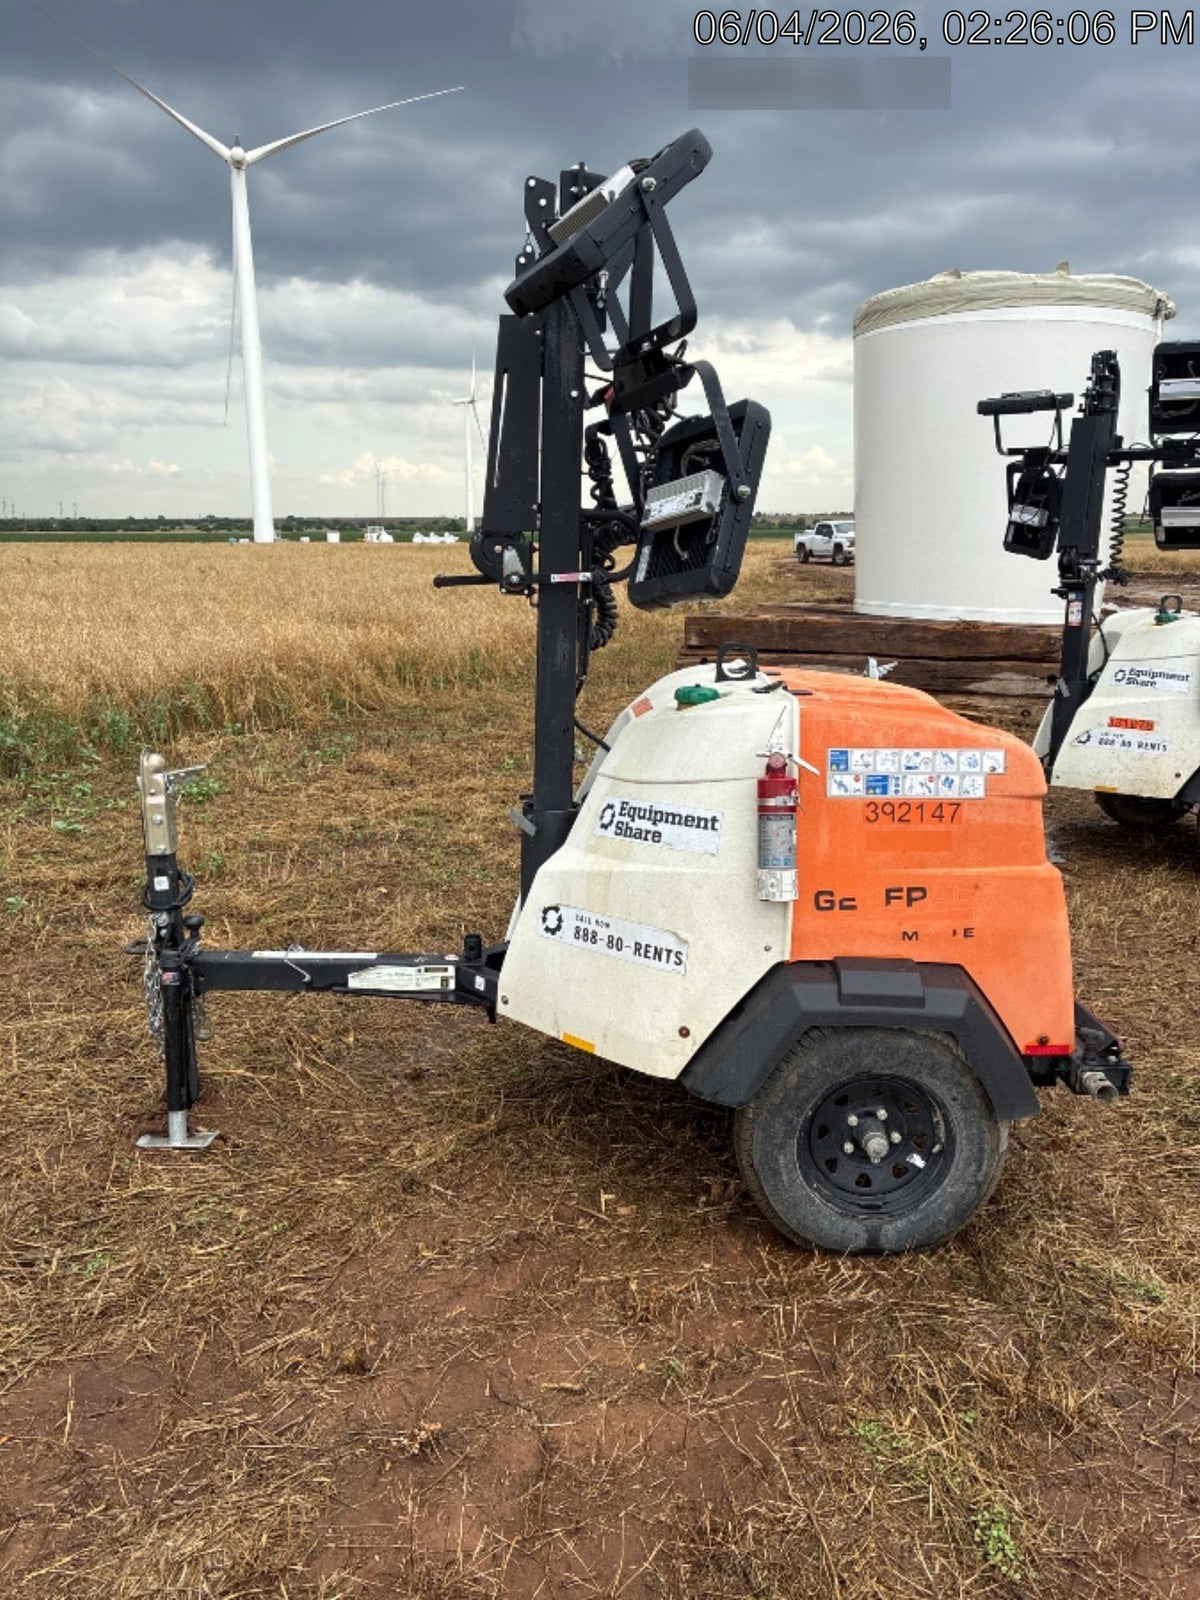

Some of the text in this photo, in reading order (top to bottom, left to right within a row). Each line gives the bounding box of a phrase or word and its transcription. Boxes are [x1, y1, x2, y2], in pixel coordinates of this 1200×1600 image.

[618, 801, 719, 832] Equipment
[865, 801, 961, 823] 392147
[614, 821, 663, 844] Share
[573, 926, 684, 966] 888-80-RENTS
